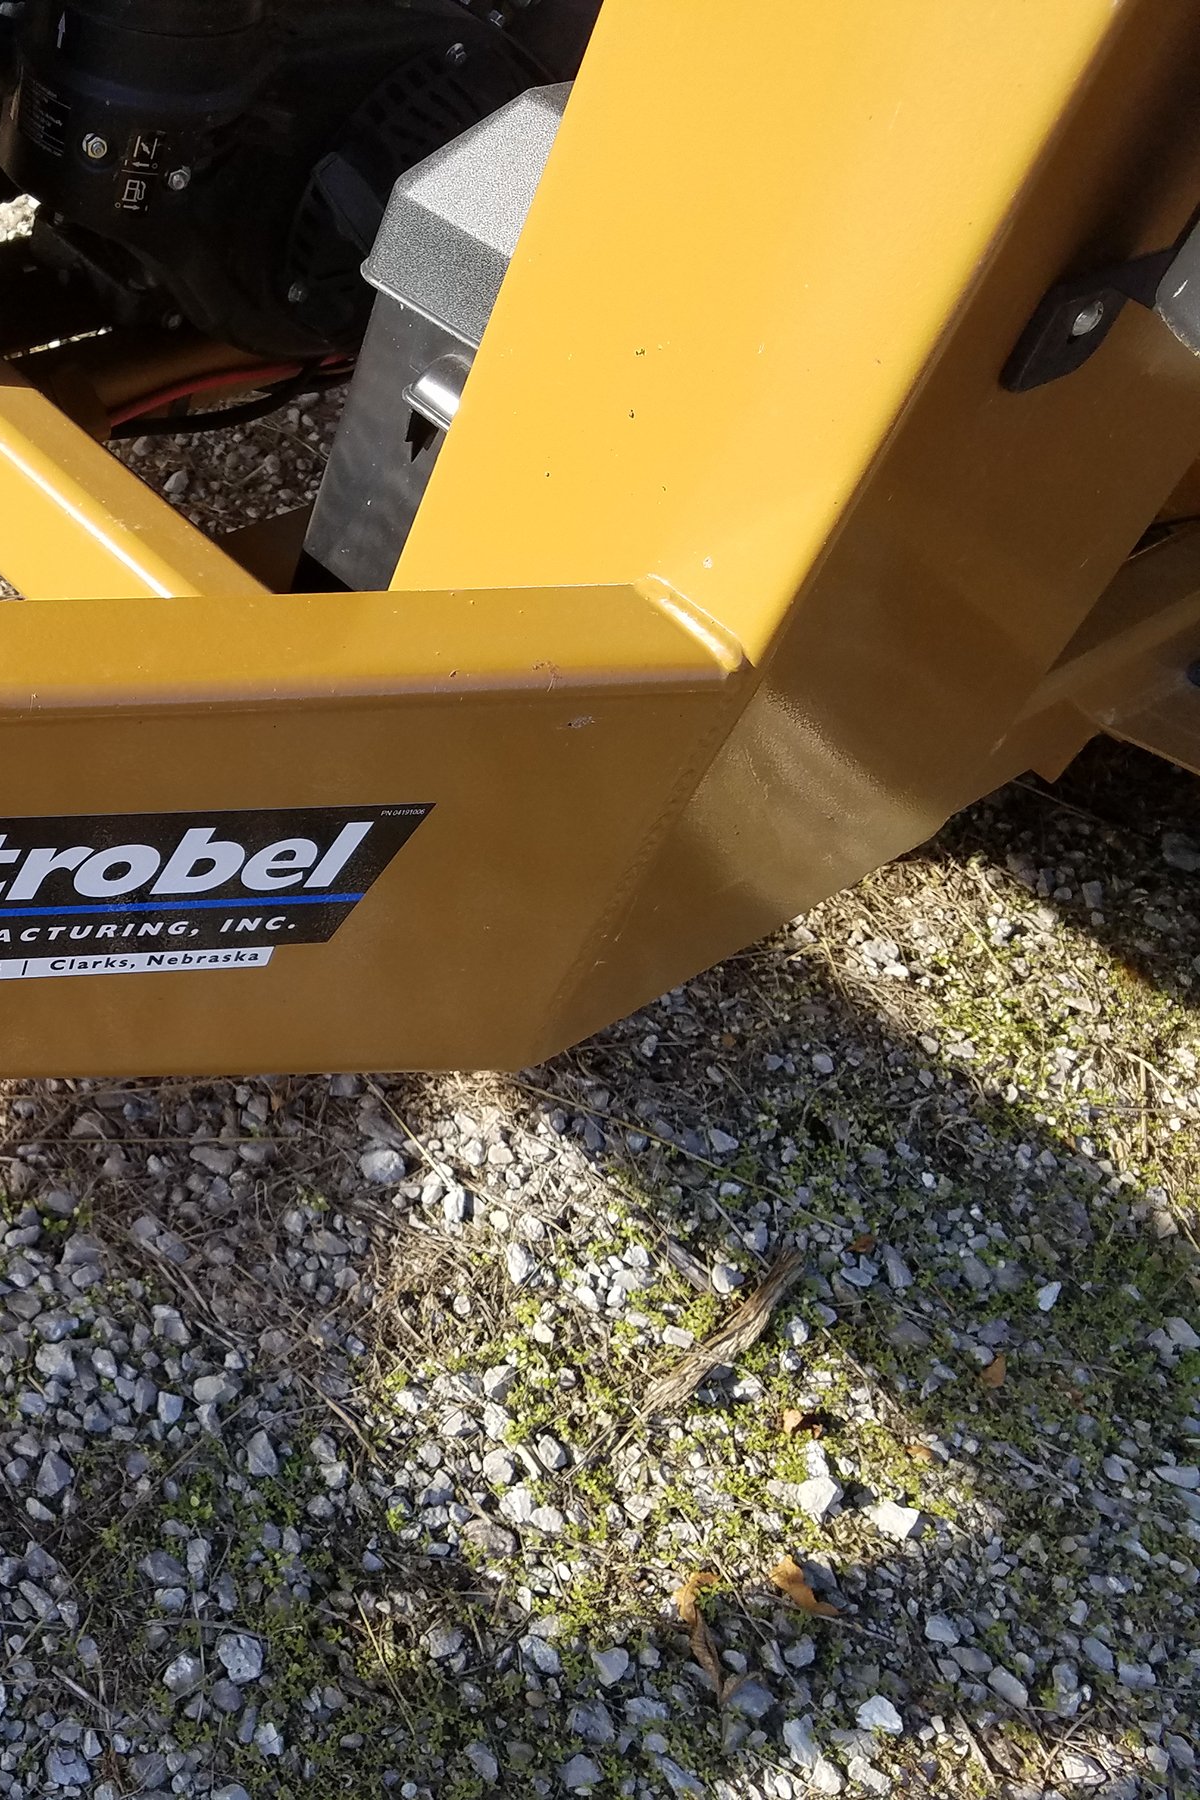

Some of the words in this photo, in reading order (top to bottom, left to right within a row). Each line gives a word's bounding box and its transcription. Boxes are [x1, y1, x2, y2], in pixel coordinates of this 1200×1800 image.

[219, 915, 297, 933] INC.
[49, 957, 137, 971] Clarks,
[146, 950, 260, 967] Nebraska
